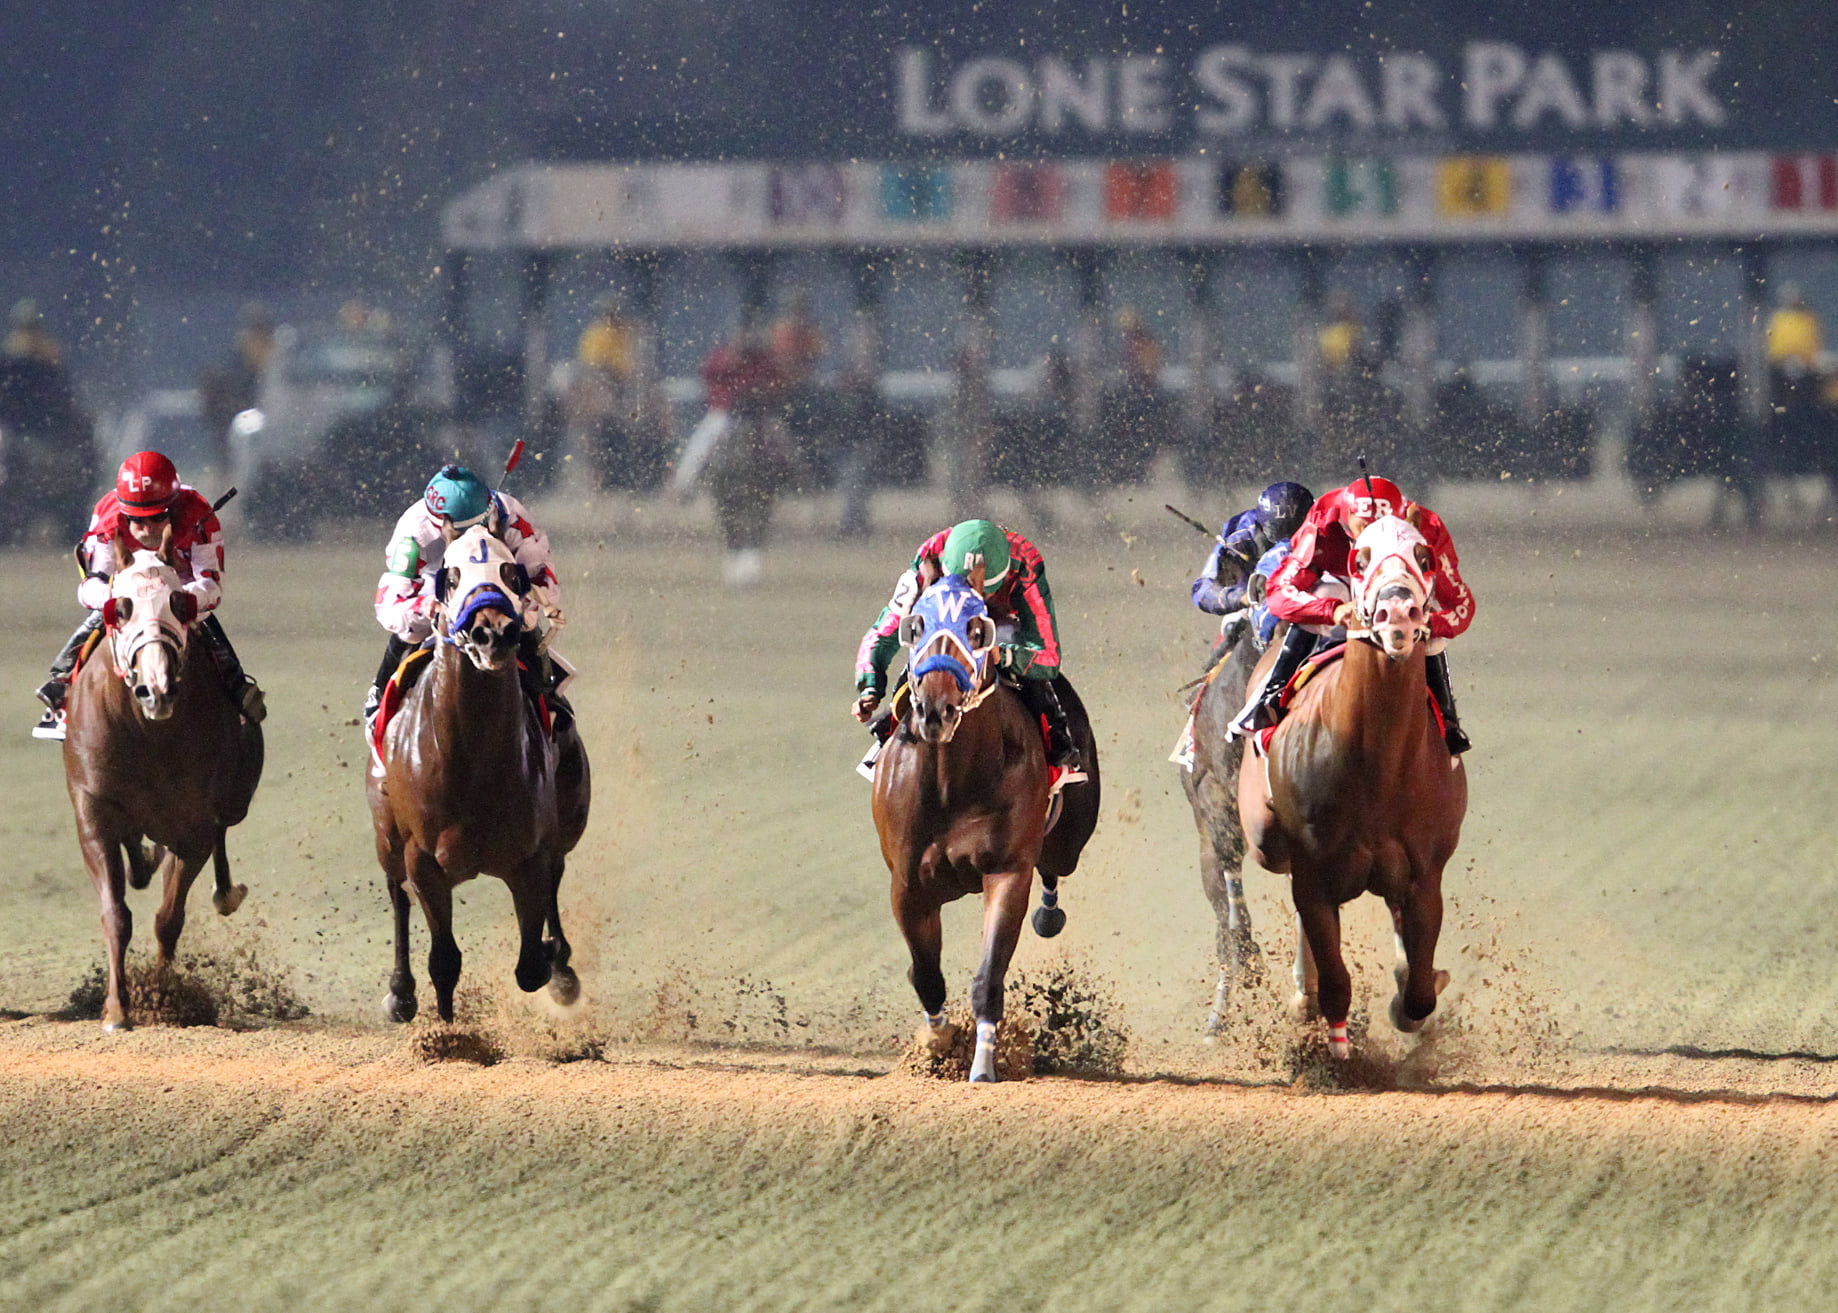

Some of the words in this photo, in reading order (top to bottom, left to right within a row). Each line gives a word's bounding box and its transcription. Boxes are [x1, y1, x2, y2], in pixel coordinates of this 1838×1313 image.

[898, 47, 1174, 135] LONE
[1195, 43, 1445, 133] STAR
[1464, 41, 1726, 130] PARK
[426, 484, 446, 511] GRC
[1355, 497, 1393, 519] ER
[1274, 504, 1297, 519] LV
[392, 543, 410, 572] 5
[893, 582, 911, 608] 2
[936, 590, 971, 623] W
